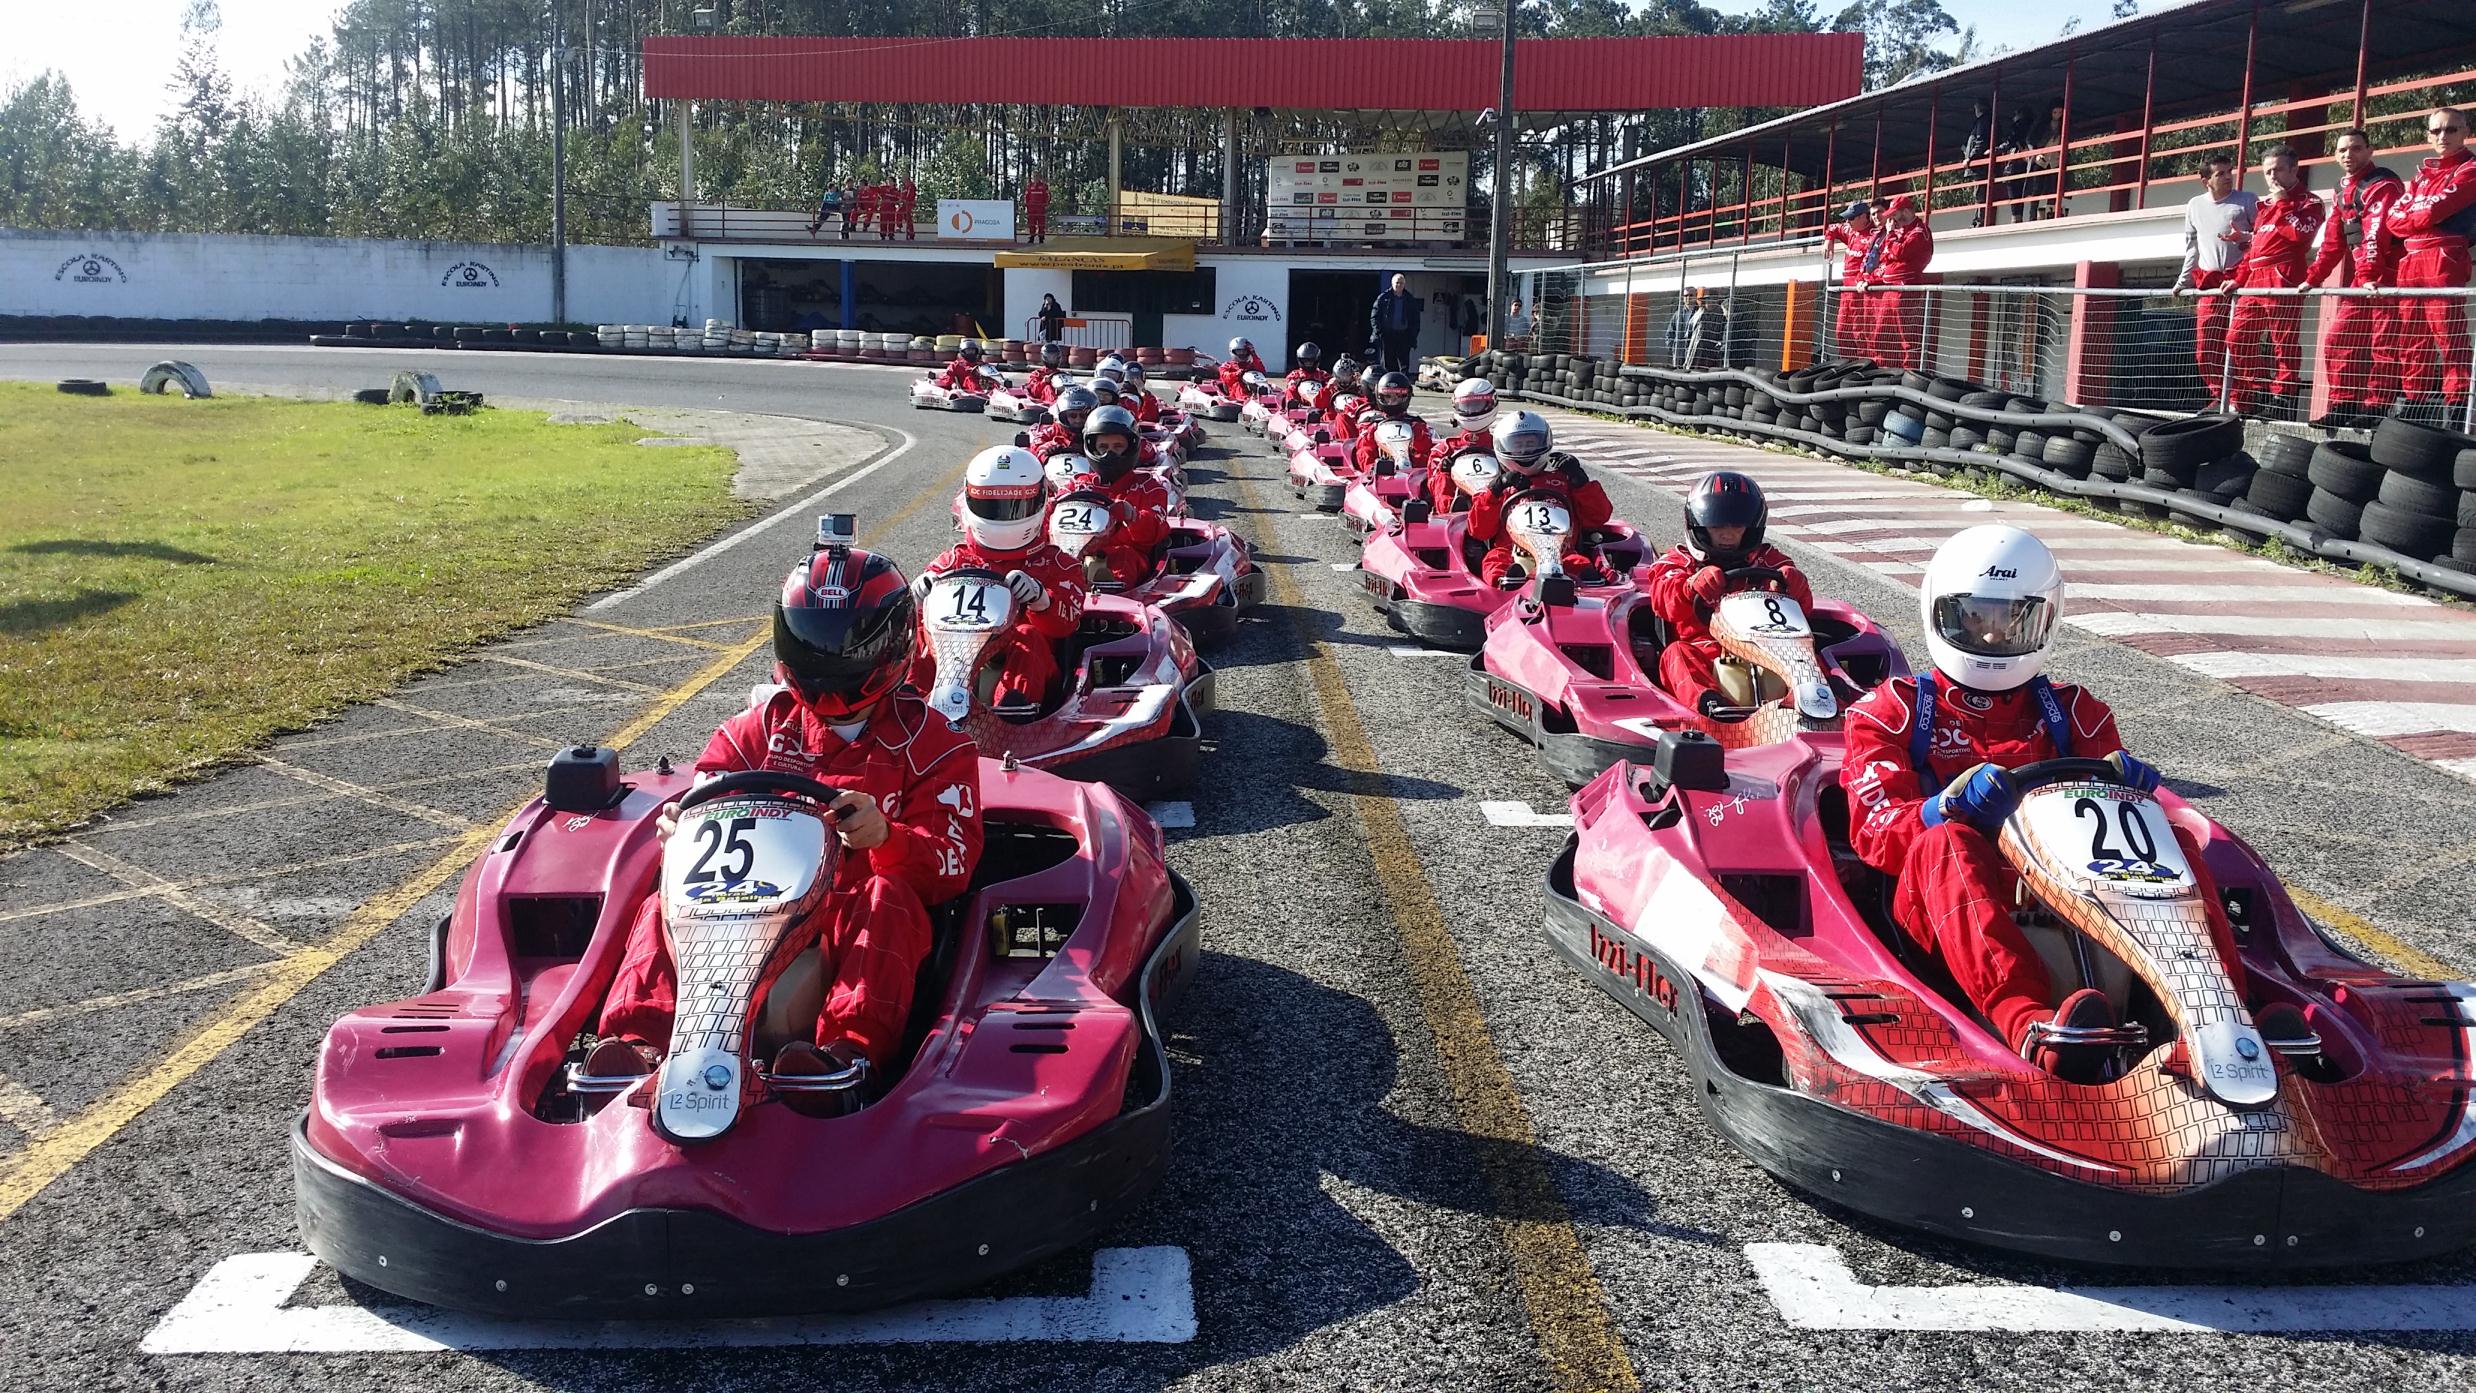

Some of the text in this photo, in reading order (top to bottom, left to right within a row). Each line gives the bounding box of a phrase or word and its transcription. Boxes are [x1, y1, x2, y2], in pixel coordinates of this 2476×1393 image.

[55, 253, 127, 283] ESCOLA KARTING
[441, 261, 499, 287] ESCOLA KARTING
[1223, 295, 1281, 321] ESCOLA KARTING
[1395, 424, 1403, 437] 7
[1064, 457, 1074, 473] 5
[1472, 458, 1483, 474] 6
[982, 489, 1023, 497] FIDELIDADE
[1058, 508, 1093, 528] 24
[1524, 506, 1551, 526] 13
[1979, 565, 2017, 579] Arai
[820, 588, 844, 596] BELL
[952, 585, 987, 618] 14
[1764, 598, 1787, 626] 8
[1919, 692, 1934, 731] sparco
[777, 762, 804, 773] CULTURAL
[2063, 788, 2146, 804] EUROINDY
[703, 807, 793, 821] EUROINDY
[2074, 797, 2158, 864] 20
[682, 817, 757, 885] 25
[2098, 859, 2155, 875] 24
[699, 880, 758, 897] 24
[2225, 1063, 2268, 1082] Spirit
[685, 1092, 730, 1113] Spirit
